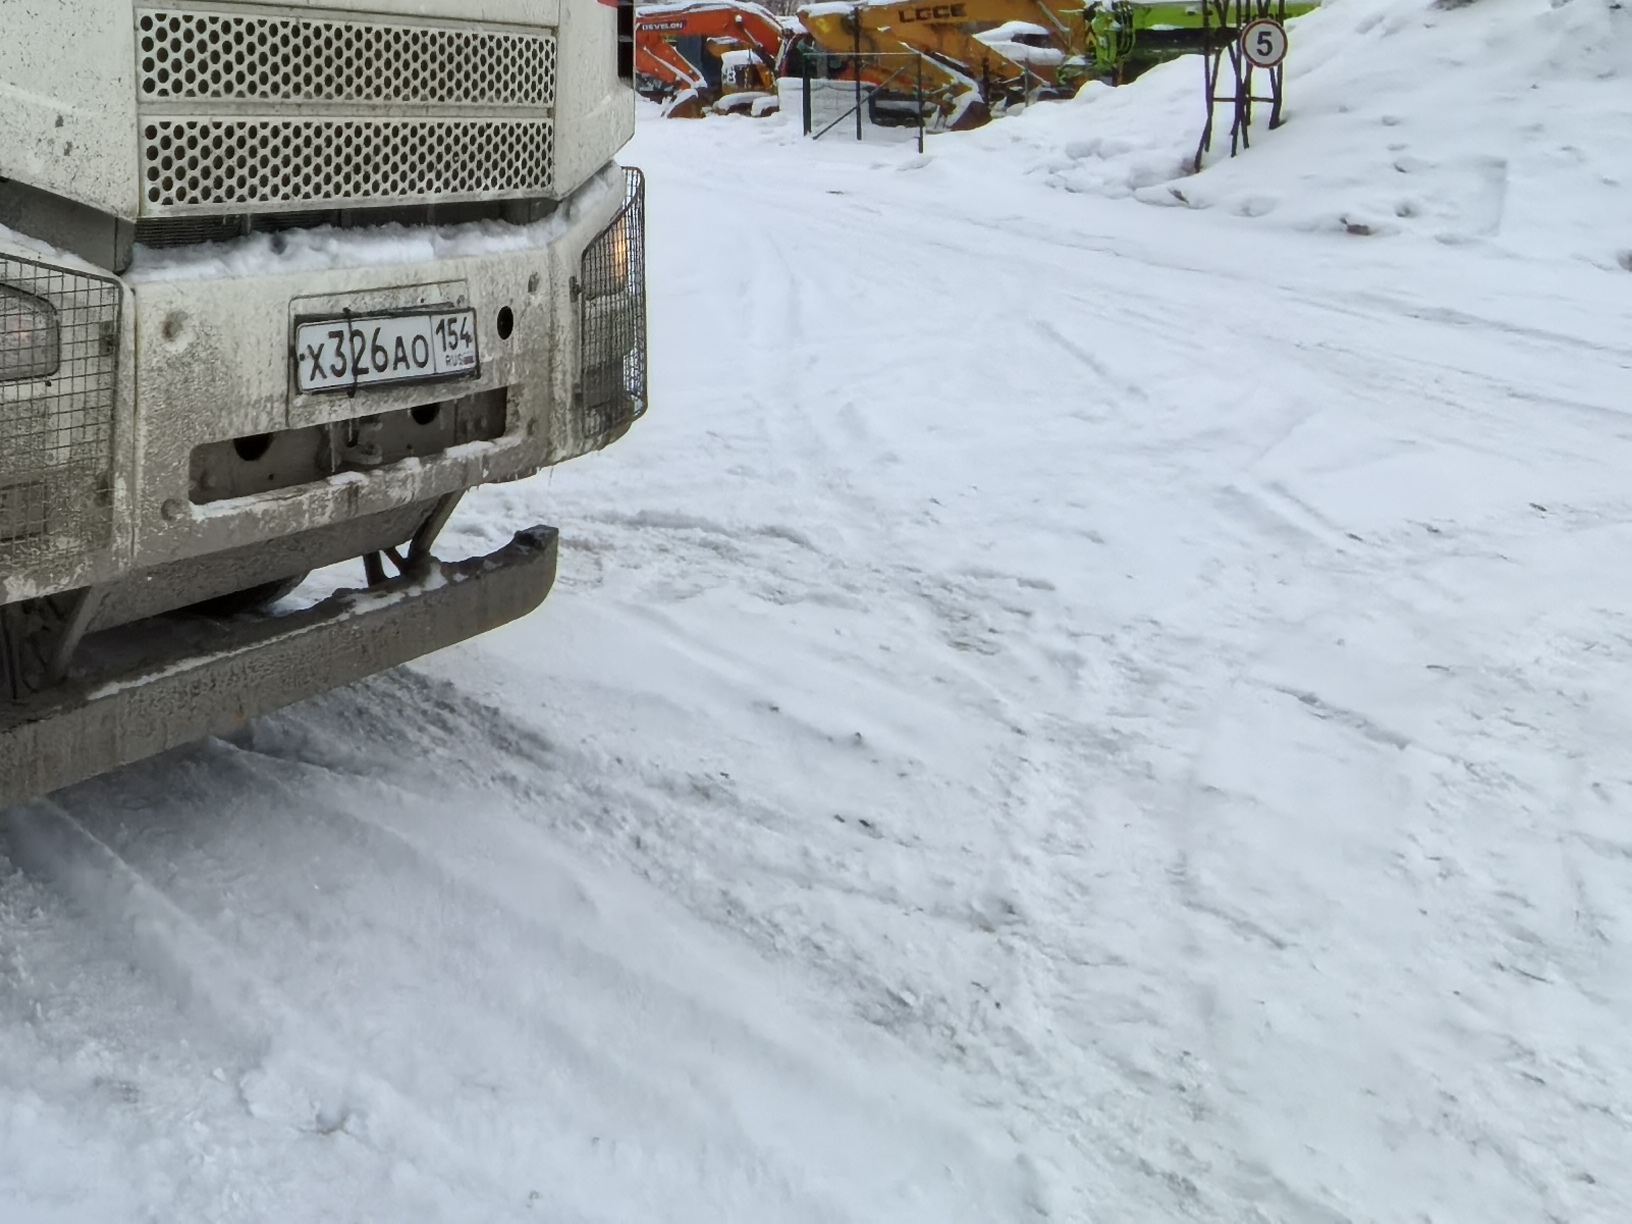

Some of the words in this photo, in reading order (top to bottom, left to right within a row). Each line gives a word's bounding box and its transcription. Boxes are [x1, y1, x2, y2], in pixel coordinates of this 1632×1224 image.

[1256, 31, 1274, 57] 5
[435, 316, 473, 352] 154
[445, 353, 464, 367] RUS
